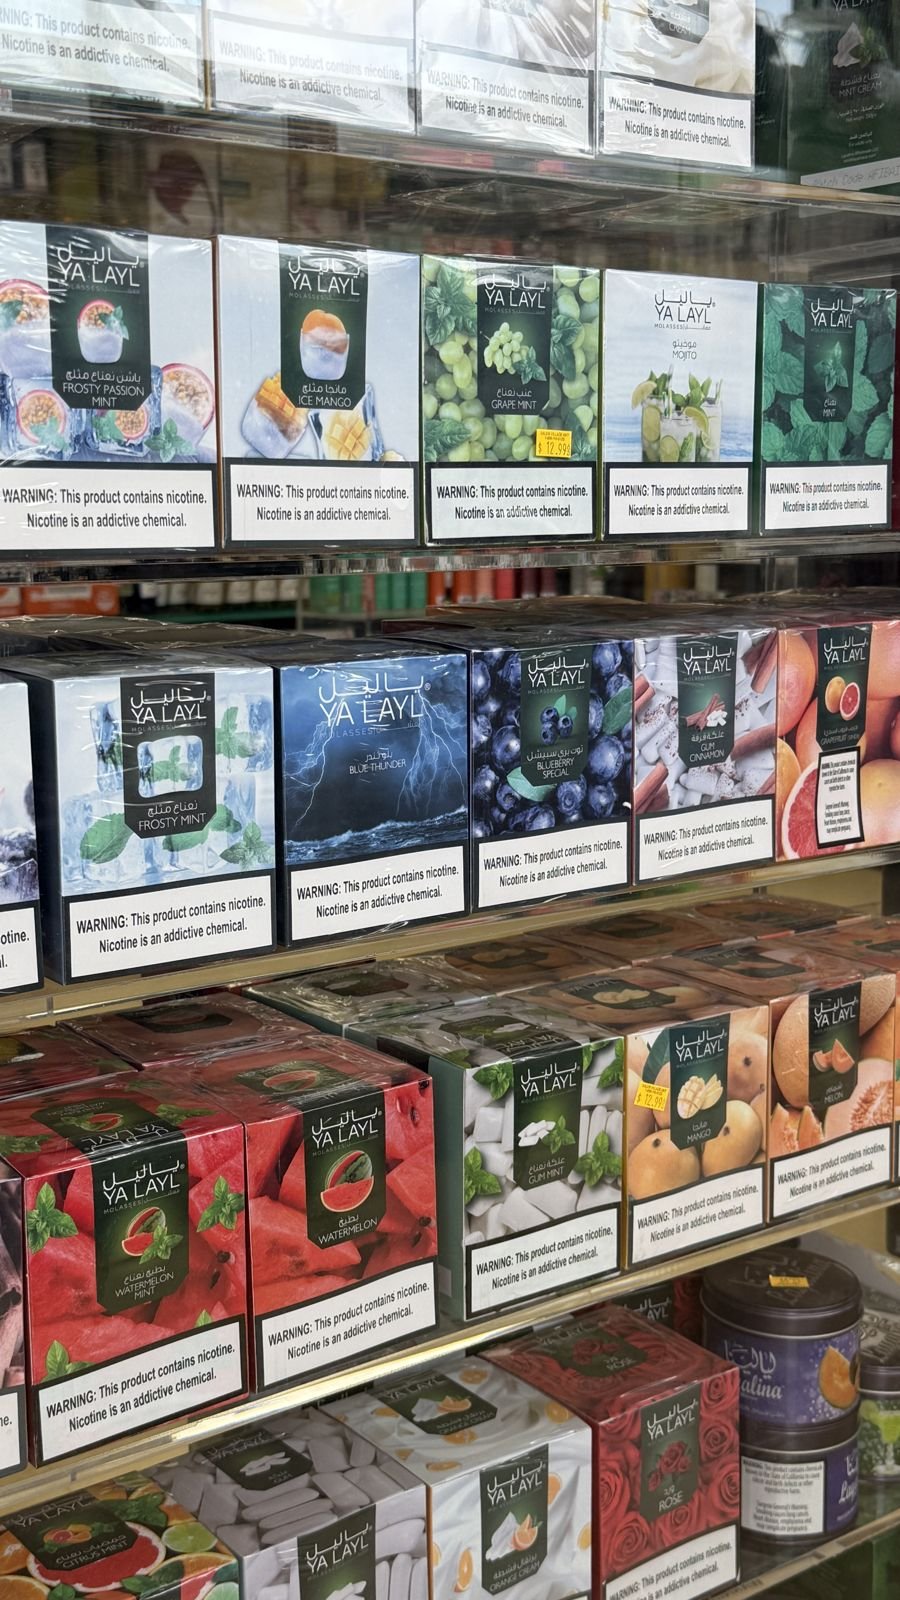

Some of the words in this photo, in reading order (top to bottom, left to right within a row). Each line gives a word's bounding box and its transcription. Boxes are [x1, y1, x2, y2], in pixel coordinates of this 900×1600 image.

[858, 82, 882, 95] CREAM
[647, 101, 662, 117] This
[662, 107, 687, 121] product
[688, 112, 715, 126] contains
[717, 114, 744, 129] nicotine.
[624, 119, 654, 136] Nicotine
[653, 124, 660, 138] is
[660, 128, 669, 139] an
[669, 127, 699, 143] addictive
[700, 132, 731, 147] chemical.
[58, 261, 86, 282] YA
[92, 265, 140, 287] LAYL
[289, 272, 312, 291] YA
[318, 275, 360, 296] LAYL
[485, 289, 505, 306] YA
[510, 291, 546, 309] LAYL
[655, 306, 673, 321] YA
[678, 307, 712, 324] LAYL
[811, 312, 827, 326] YA
[831, 313, 853, 328] LAYL
[672, 350, 697, 361] MOJITO
[63, 382, 101, 394] FROSTY
[104, 385, 145, 397] PASSION
[92, 396, 117, 407] MINT
[298, 395, 313, 406] ICE
[316, 396, 351, 408] MANGO
[491, 400, 516, 410] GRAPE
[518, 401, 537, 410] MINT
[236, 483, 283, 498] WARNING:
[286, 484, 303, 498] This
[306, 485, 338, 502] product
[338, 485, 373, 499] contains
[374, 485, 409, 500] nicotine.
[613, 484, 649, 497] WARNING:
[651, 484, 664, 496] This
[666, 484, 690, 499] product
[690, 484, 716, 496] contains
[717, 483, 743, 495] nicotine.
[256, 506, 292, 521] Nicotine
[294, 507, 301, 520] is
[303, 510, 314, 520] an
[316, 507, 352, 521] addictive
[353, 507, 391, 521] chemical.
[628, 504, 655, 516] Nicotine
[656, 503, 662, 516] is
[663, 506, 671, 515] an
[672, 503, 701, 515] addictive
[701, 502, 730, 515] chemical.
[824, 651, 840, 664] YA
[843, 648, 866, 663] LAYL
[684, 661, 701, 675] YA
[706, 658, 732, 674] LAYL
[528, 673, 547, 688] YA
[551, 670, 585, 686] LAYL
[131, 707, 157, 724] YA
[163, 704, 207, 722] LAYL
[320, 701, 355, 727] YA
[363, 695, 424, 724] LAYL
[690, 750, 725, 762] CINNAMON
[701, 742, 715, 752] GUM
[349, 764, 368, 774] BLUE
[371, 759, 406, 771] THUNDER
[537, 757, 575, 770] BLUEBERRY
[543, 768, 569, 779] SPECIAL
[139, 818, 178, 831] FROSTY
[181, 813, 207, 826] MINT
[296, 882, 341, 901] WARNING:
[343, 879, 360, 893] This
[361, 874, 391, 893] product
[391, 869, 424, 885] contains
[426, 864, 458, 879] nicotine.
[316, 902, 349, 918] Nicotine
[351, 900, 358, 912] is
[359, 900, 369, 911] an
[370, 892, 405, 909] addictive
[406, 885, 442, 902] chemical.
[76, 914, 128, 934] WARNING:
[130, 911, 150, 926] This
[152, 905, 187, 926] product
[188, 900, 226, 917] contains
[228, 895, 266, 911] nicotine.
[99, 936, 138, 953] Nicotine
[140, 933, 148, 947] is
[150, 933, 161, 945] an
[163, 925, 204, 943] addictive
[205, 917, 247, 936] chemical.
[815, 1014, 830, 1028] YA
[833, 1006, 856, 1024] LAYL
[676, 1048, 693, 1062] YA
[696, 1040, 724, 1058] LAYL
[520, 1082, 540, 1097] YA
[544, 1074, 576, 1093] LAYL
[312, 1132, 334, 1149] YA
[339, 1120, 378, 1143] LAYL
[687, 1128, 711, 1144] MANGO
[528, 1174, 546, 1185] GUM
[546, 1167, 564, 1179] MINT
[104, 1187, 128, 1205] YA
[135, 1174, 180, 1198] LAYL
[318, 1217, 378, 1244] WATERMELON
[115, 1272, 174, 1297] WATERMELON
[134, 1287, 155, 1300] MINT
[267, 1322, 312, 1347] WARNING:
[314, 1315, 331, 1331] This
[333, 1303, 363, 1327] product
[363, 1293, 396, 1312] contains
[397, 1281, 429, 1300] nicotine.
[287, 1340, 320, 1360] Nicotine
[322, 1336, 330, 1348] is
[331, 1333, 341, 1345] an
[343, 1320, 377, 1340] addictive
[377, 1303, 413, 1326] chemical.
[45, 1390, 96, 1418] WARNING:
[98, 1382, 118, 1398] This
[121, 1368, 155, 1394] product
[157, 1355, 195, 1377] contains
[197, 1343, 235, 1364] nicotine.
[69, 1409, 107, 1431] Nicotine
[109, 1404, 117, 1417] is
[120, 1400, 131, 1413] an
[133, 1385, 173, 1408] addictive
[175, 1367, 217, 1392] chemical.
[648, 1424, 664, 1440] YA
[667, 1410, 695, 1434] LAYL
[488, 1491, 506, 1506] YA
[510, 1473, 543, 1498] LAYL
[658, 1490, 683, 1512] ROSE
[307, 1555, 328, 1574] YA
[333, 1536, 369, 1564] LAYL
[490, 1574, 517, 1593] ORANGE
[517, 1561, 540, 1579] CREAM
